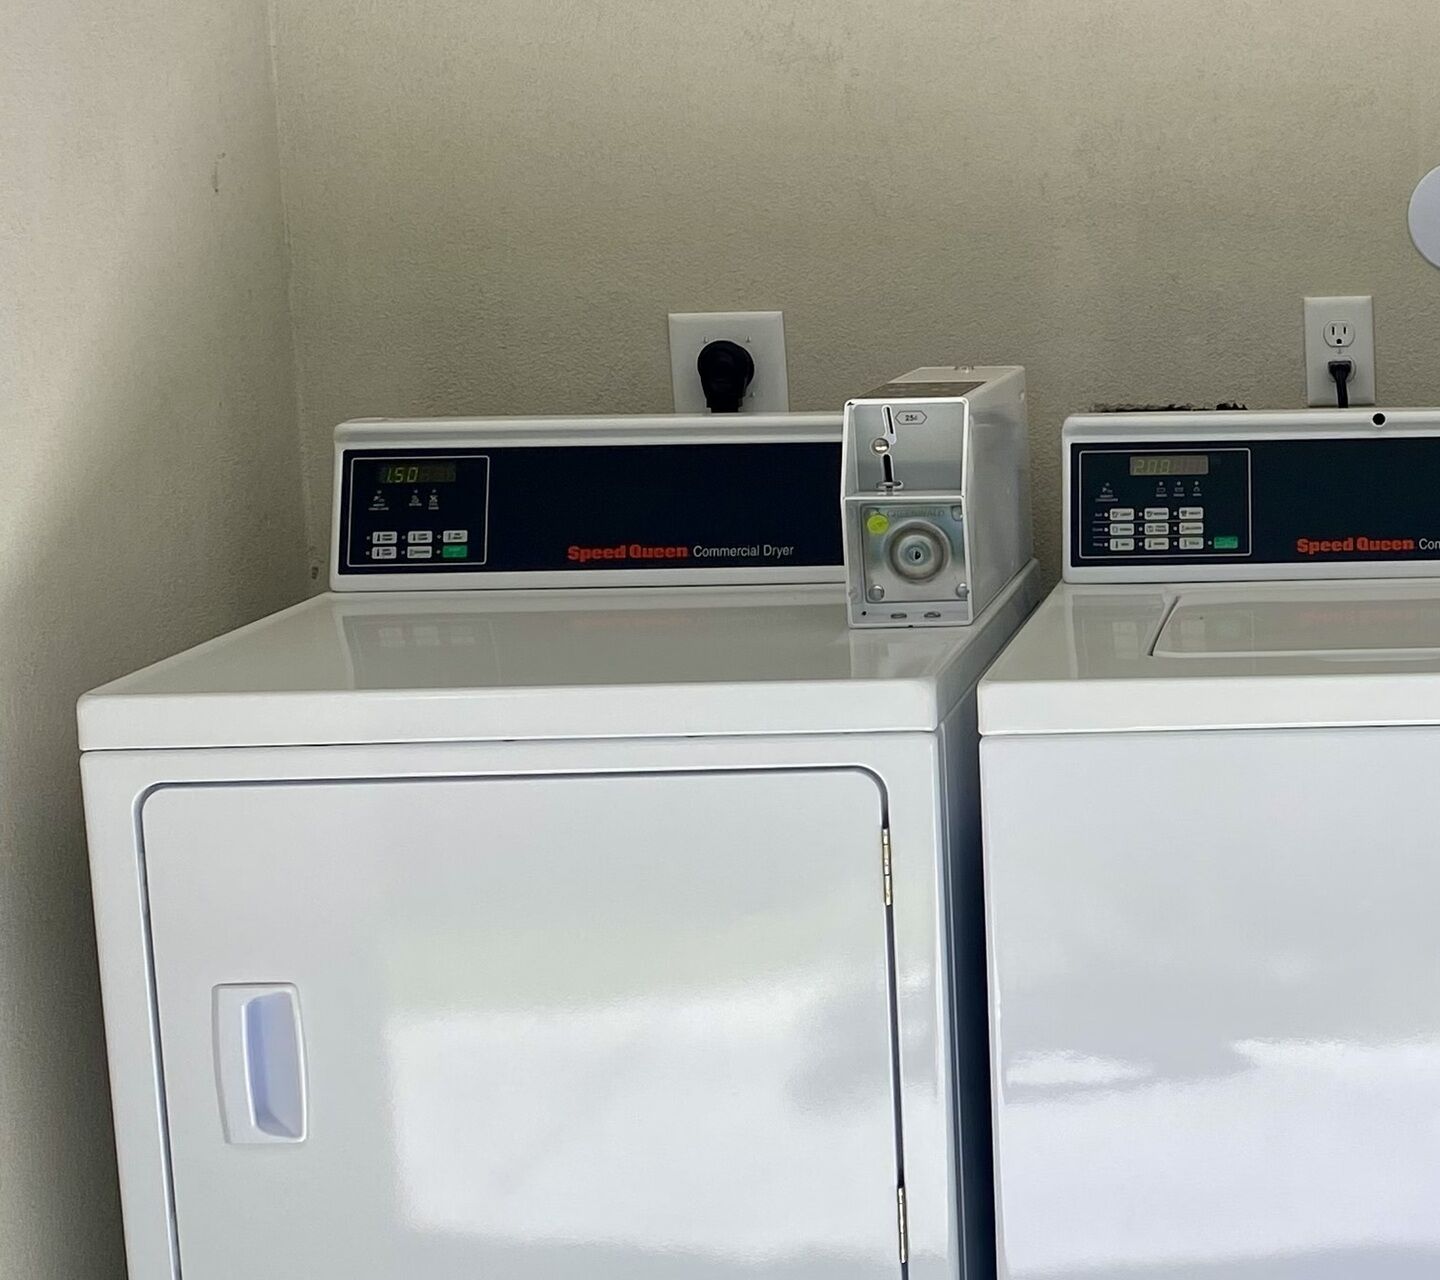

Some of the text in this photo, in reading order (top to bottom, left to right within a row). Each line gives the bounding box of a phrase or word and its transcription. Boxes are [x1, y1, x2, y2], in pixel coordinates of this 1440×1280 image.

[567, 544, 795, 562] Speed Queen Commercial Dryer
[1296, 537, 1354, 555] Speed
[1357, 536, 1414, 551] Queen
